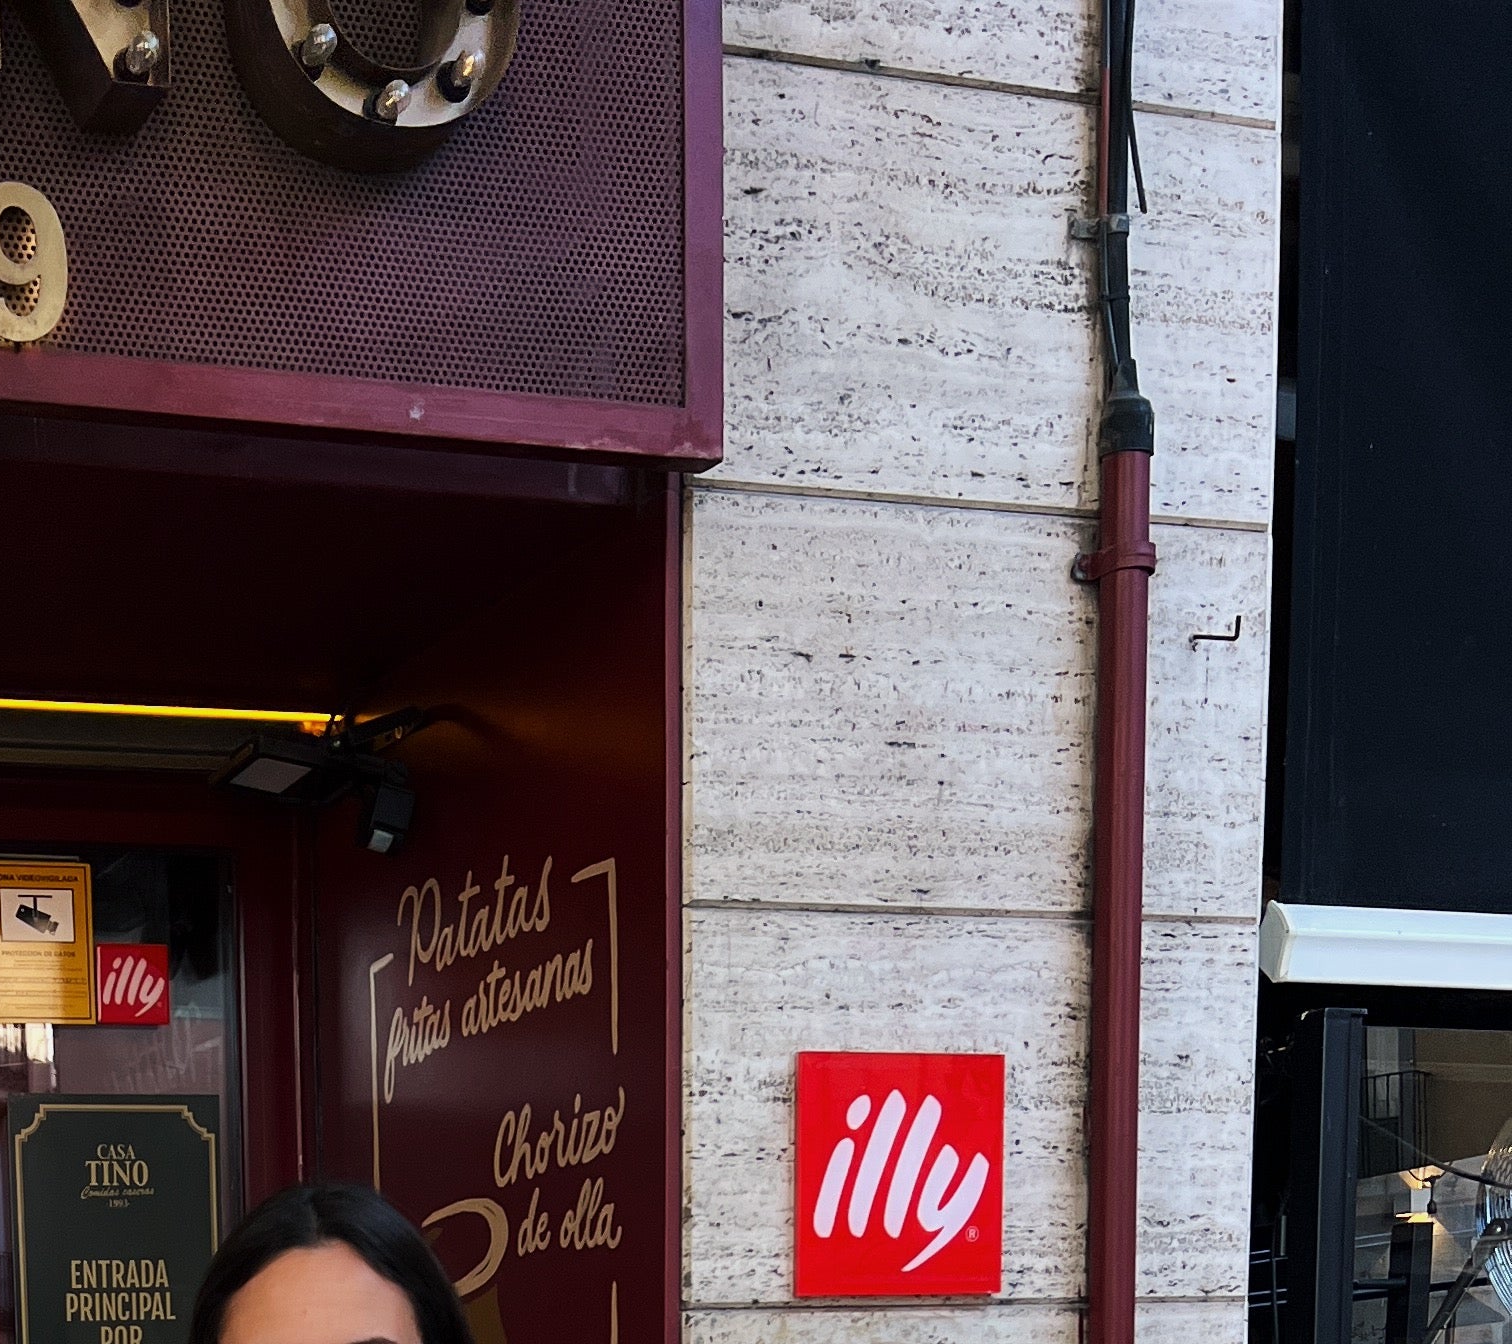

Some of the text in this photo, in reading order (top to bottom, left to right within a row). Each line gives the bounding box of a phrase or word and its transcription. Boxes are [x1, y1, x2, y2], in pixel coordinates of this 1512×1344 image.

[397, 854, 554, 987] Patatas
[102, 956, 165, 1017] illy
[384, 938, 594, 1104] fritas artesanas
[96, 1144, 136, 1160] CASA
[494, 1086, 625, 1188] Chorizo
[84, 1160, 149, 1187] TINO
[813, 1089, 990, 1273] illy
[517, 1177, 622, 1257] de olla
[65, 1292, 176, 1322] PRINCIPAL
[70, 1259, 169, 1289] ENTRADA
